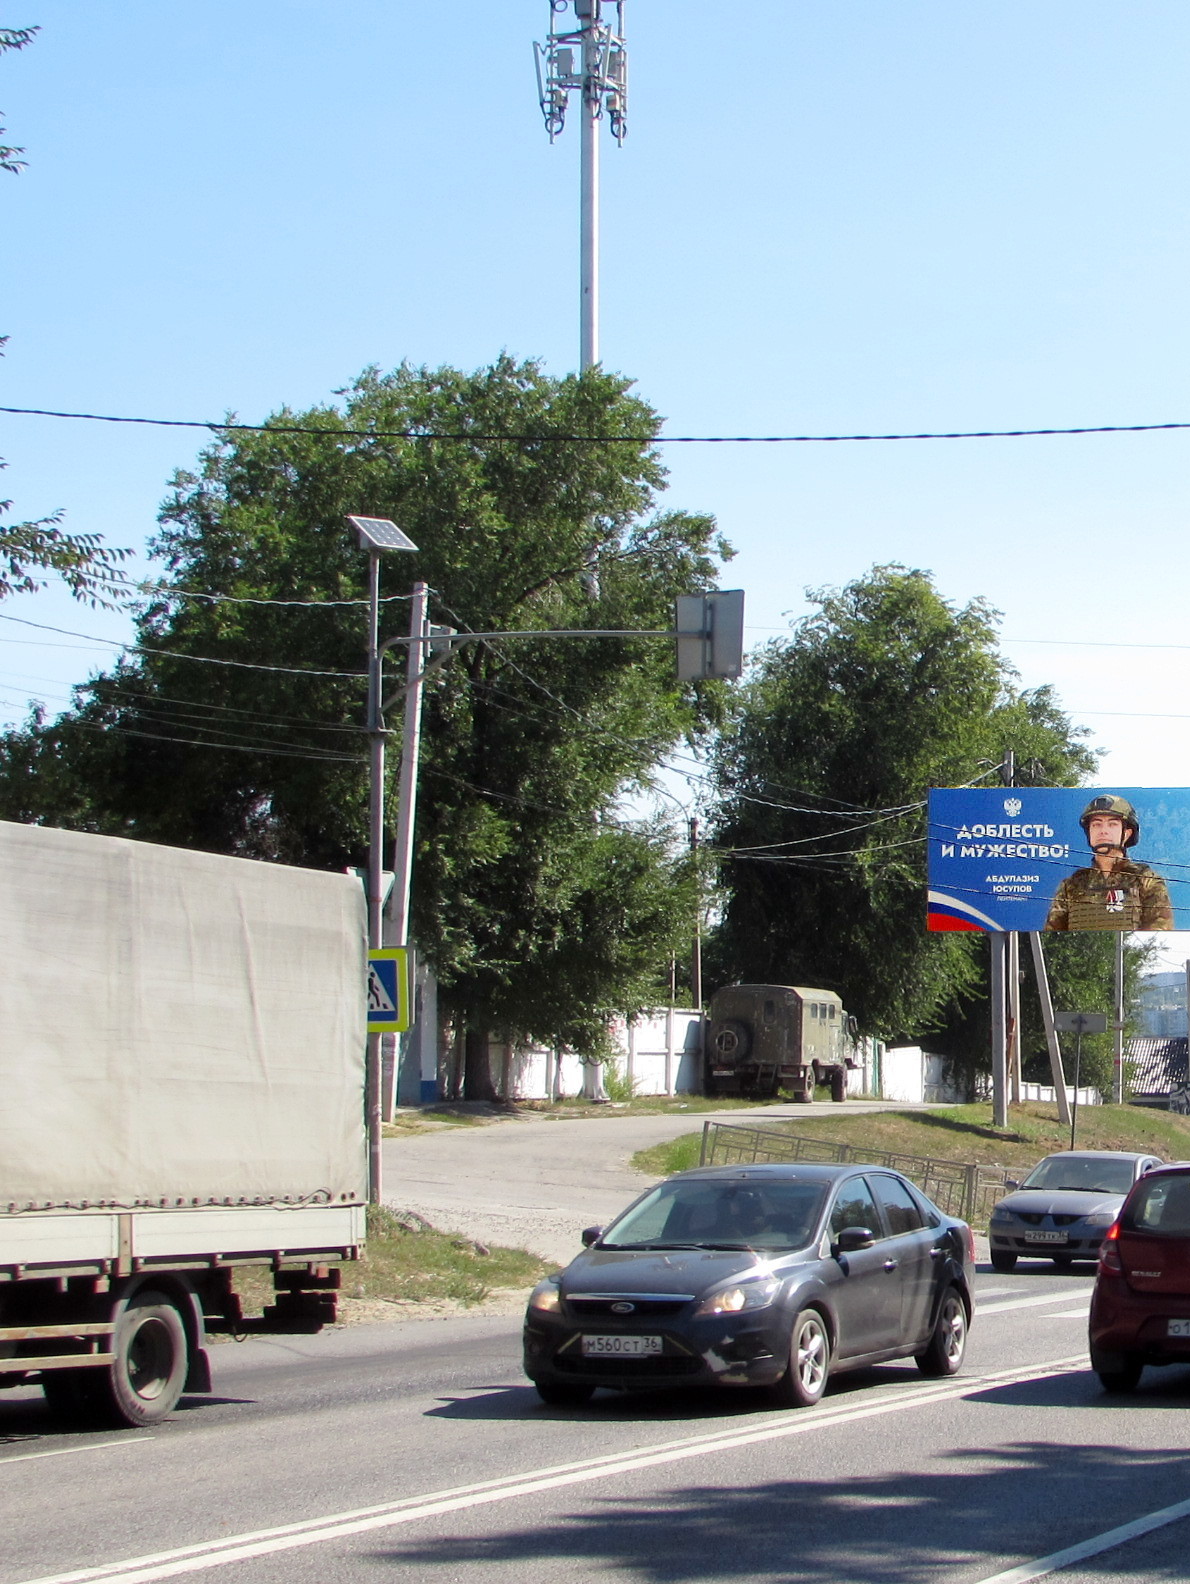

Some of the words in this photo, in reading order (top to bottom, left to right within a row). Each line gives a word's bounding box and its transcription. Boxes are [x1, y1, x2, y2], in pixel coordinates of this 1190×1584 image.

[956, 824, 1055, 839] ДОБЛЕСТЬ
[941, 844, 955, 858] И
[960, 844, 1069, 858] МУЖЕСТВО!
[985, 875, 1040, 883] АБДУЛАЗИЗ
[993, 885, 1033, 893] ЮСУПОВ
[586, 1337, 640, 1352] М560СТ
[643, 1337, 658, 1348] 36
